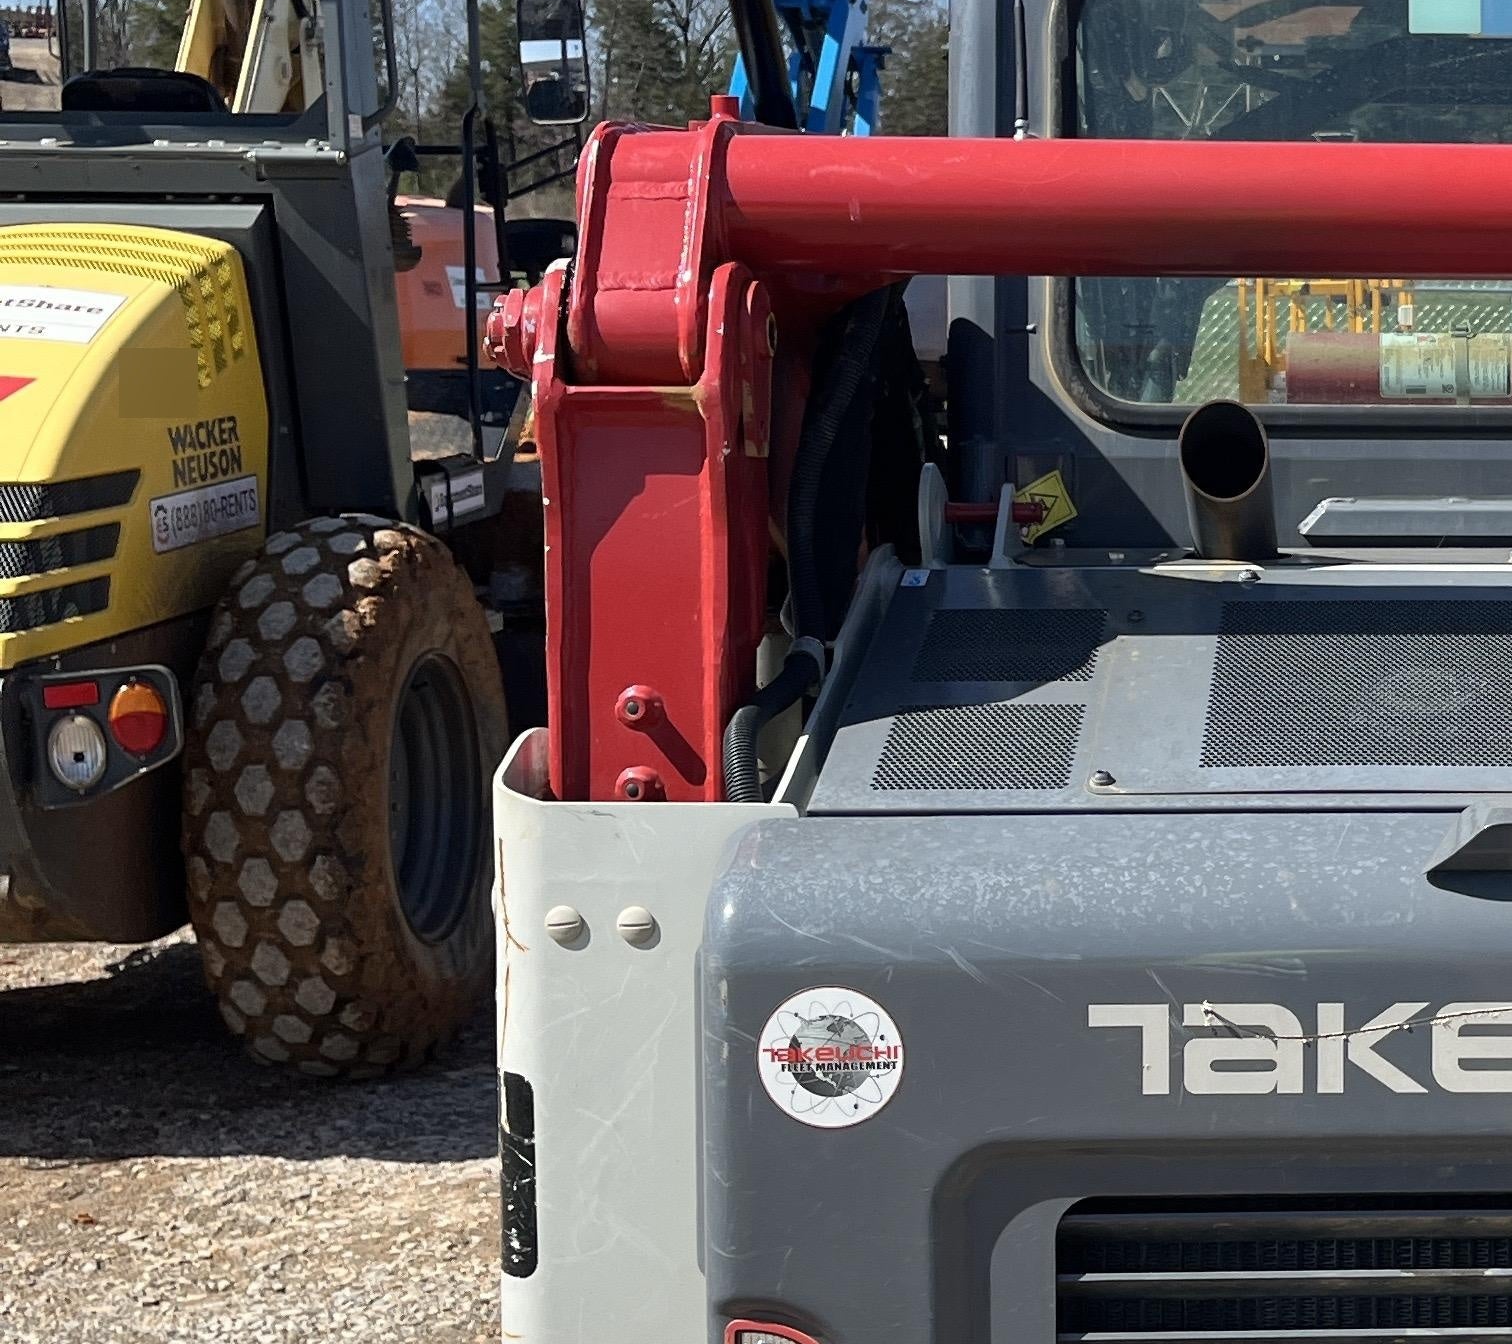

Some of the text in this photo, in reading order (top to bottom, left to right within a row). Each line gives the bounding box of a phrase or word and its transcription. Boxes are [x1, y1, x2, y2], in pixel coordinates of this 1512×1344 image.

[167, 415, 240, 455] WACKER
[172, 445, 243, 488] NEUSON
[762, 1044, 901, 1064] TAKEUCHI
[780, 1060, 899, 1073] FLEET MANAGEMENT
